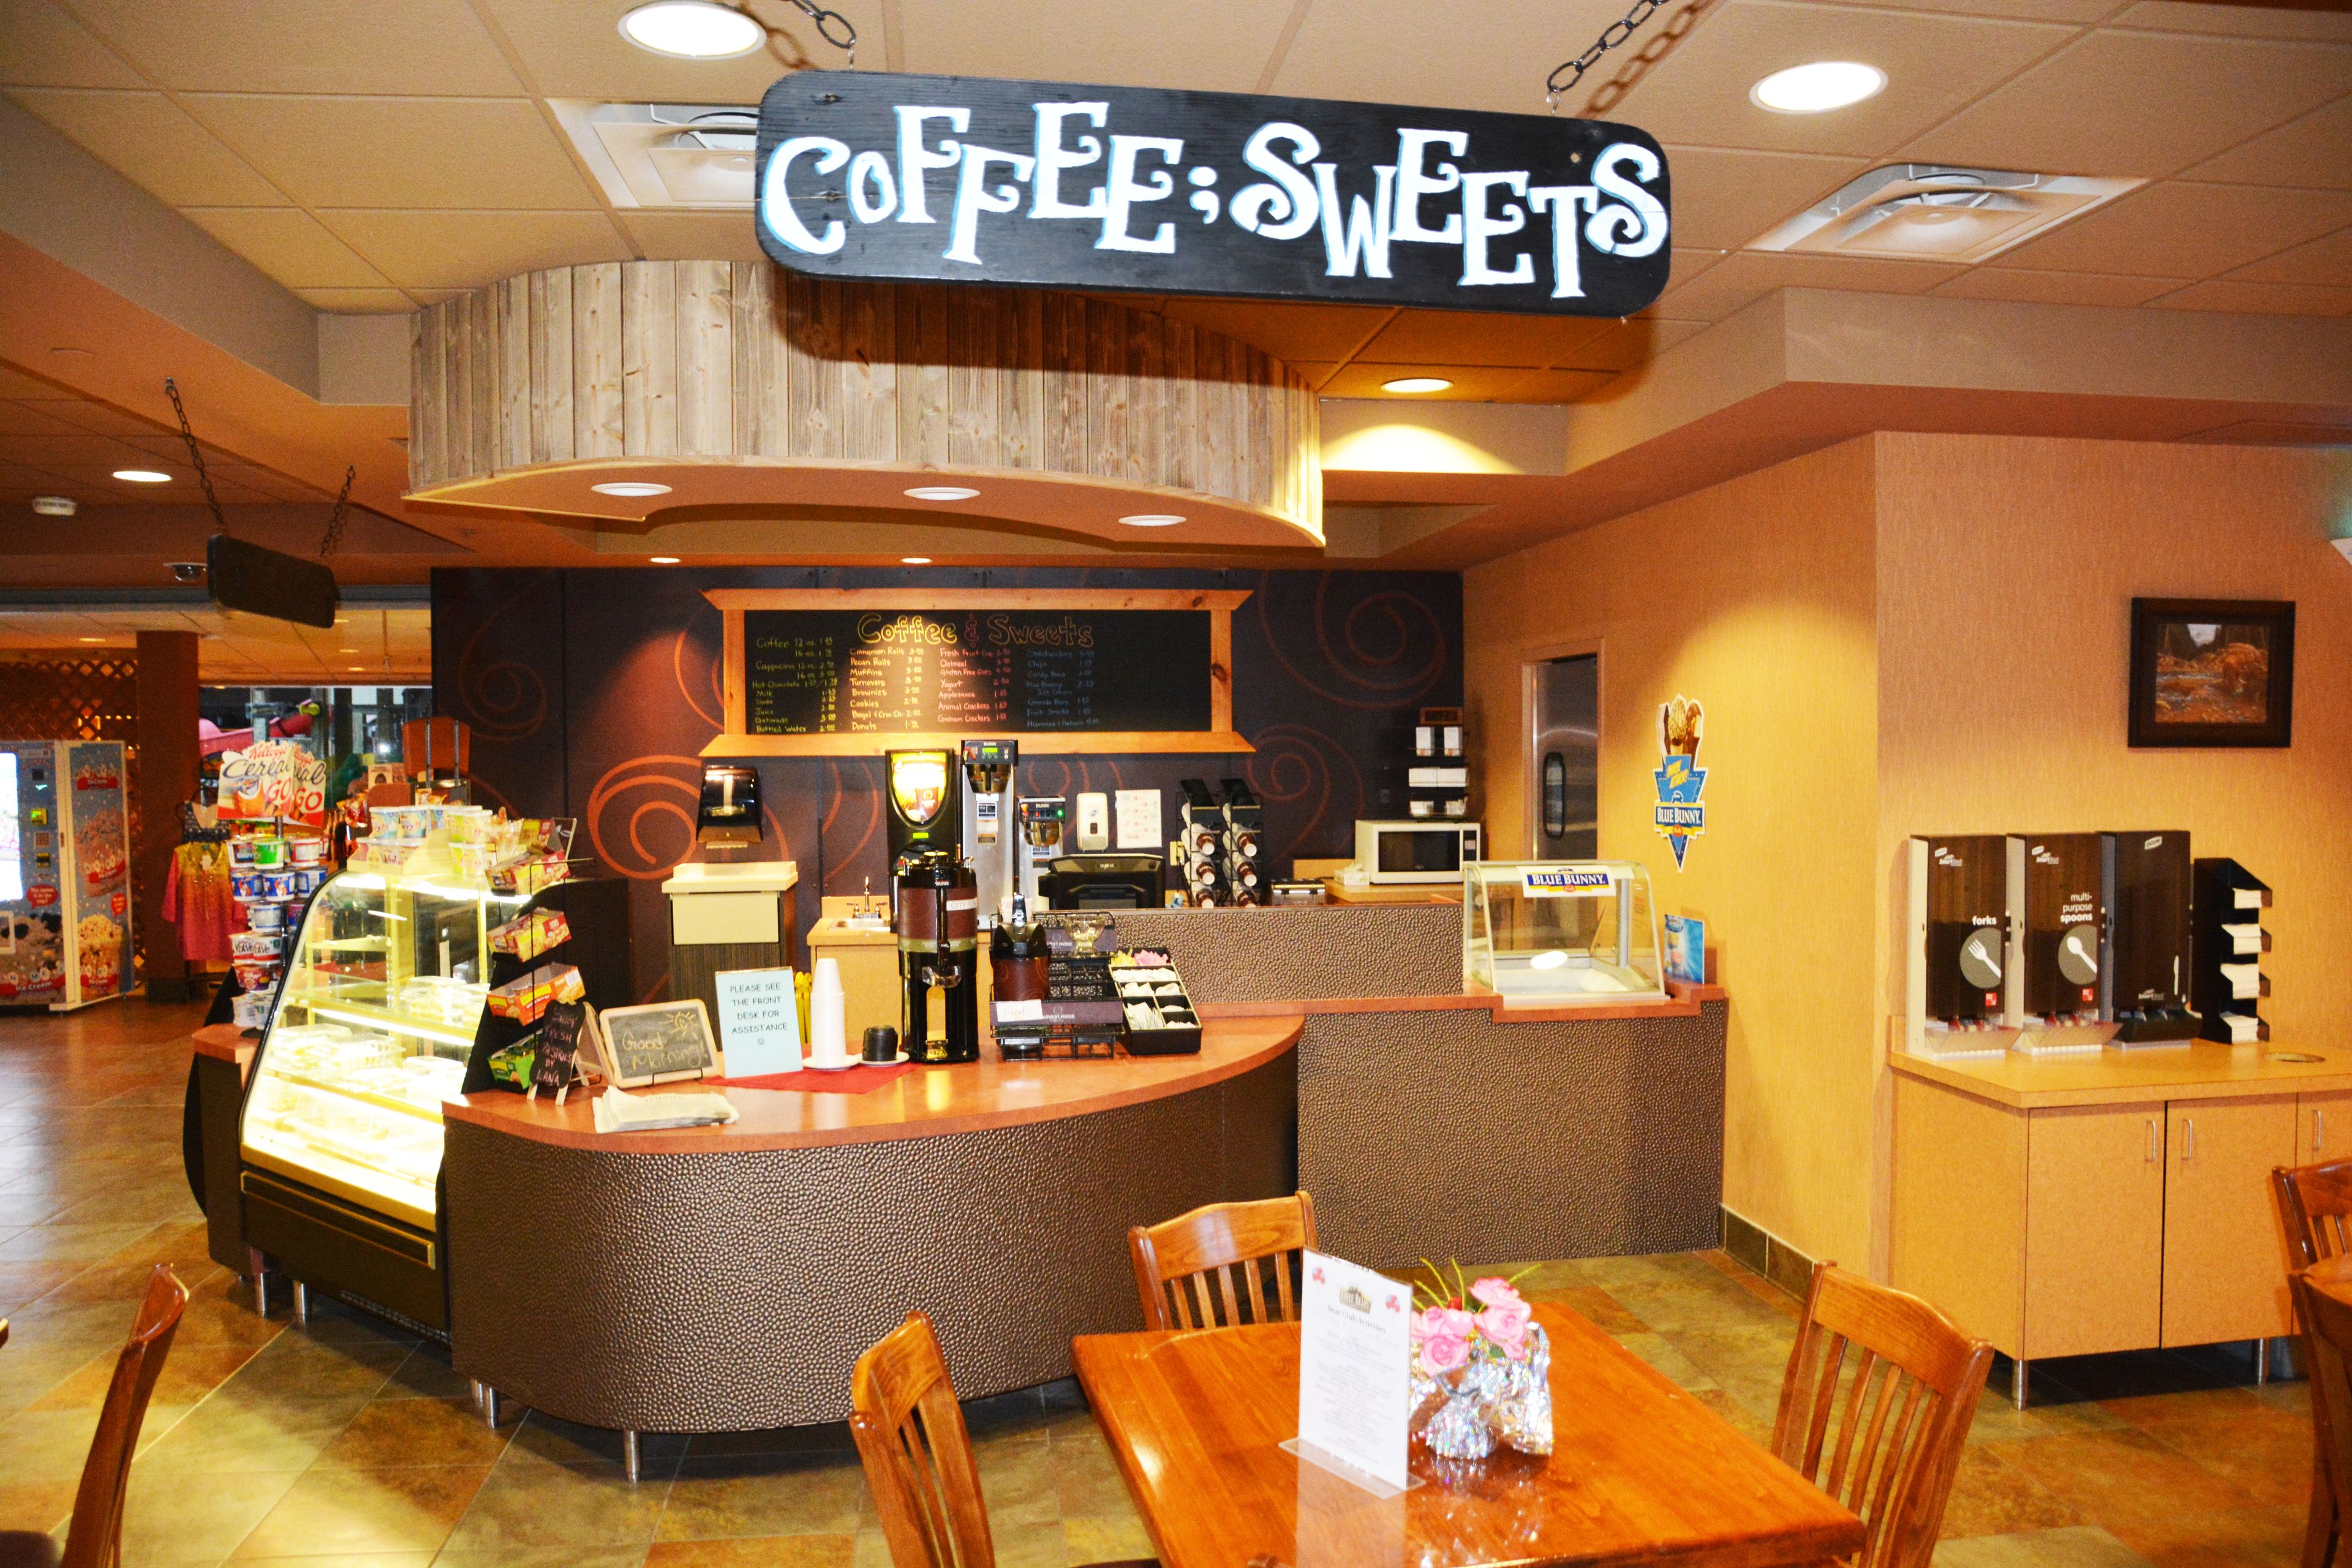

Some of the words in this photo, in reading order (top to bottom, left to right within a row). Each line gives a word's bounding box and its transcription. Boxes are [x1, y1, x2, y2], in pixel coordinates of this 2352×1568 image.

[1229, 121, 1670, 300] SWEETS
[858, 613, 957, 645] Coffee
[987, 614, 1095, 647] Sweets
[756, 637, 790, 649] Coffee
[850, 647, 886, 656] Cinnamon
[887, 646, 905, 655] Rolls
[940, 647, 960, 657] Fresh
[850, 657, 871, 666] Pecan
[873, 657, 891, 666] Rolls
[940, 659, 968, 668] Oatmeal
[850, 677, 886, 687] Turnovers
[940, 679, 964, 691] Yogurt
[852, 688, 888, 697] Brownies
[938, 691, 976, 699] Applesauce
[850, 698, 879, 708] Cookies
[938, 701, 962, 710] Animal
[963, 702, 990, 710] Crackers
[755, 707, 774, 715] Juice
[851, 710, 872, 720] Bagel
[937, 714, 963, 723] Graham
[965, 714, 991, 723] Crackers
[852, 722, 877, 731] Donuts
[248, 744, 287, 760] Kellogg's
[222, 754, 292, 779] Cereal
[268, 776, 292, 802] GO
[294, 786, 323, 812] GO
[1657, 807, 1674, 823] BLUE
[1674, 807, 1701, 824] BUNNY
[1532, 874, 1563, 885] BLUE
[1563, 873, 1605, 885] BUNNY
[2070, 891, 2093, 902] multi-
[2062, 903, 2093, 914] purpose
[1972, 915, 1997, 926] forks
[2060, 913, 2093, 924] spoons
[729, 984, 761, 993] PLEASE
[765, 982, 781, 991] SEE
[752, 996, 782, 1005] FRONT
[737, 1011, 760, 1021] DESK
[762, 1010, 780, 1019] FOR
[545, 1025, 572, 1043] FRESH
[731, 1022, 788, 1035] ASSISTANCE
[622, 1030, 664, 1051] Good
[631, 1039, 708, 1070] Morning!
[545, 1058, 556, 1068] BY
[536, 1069, 559, 1087] LANA
[1327, 1304, 1340, 1316] Bear
[1341, 1311, 1357, 1322] Club
[1358, 1316, 1386, 1334] Activities
